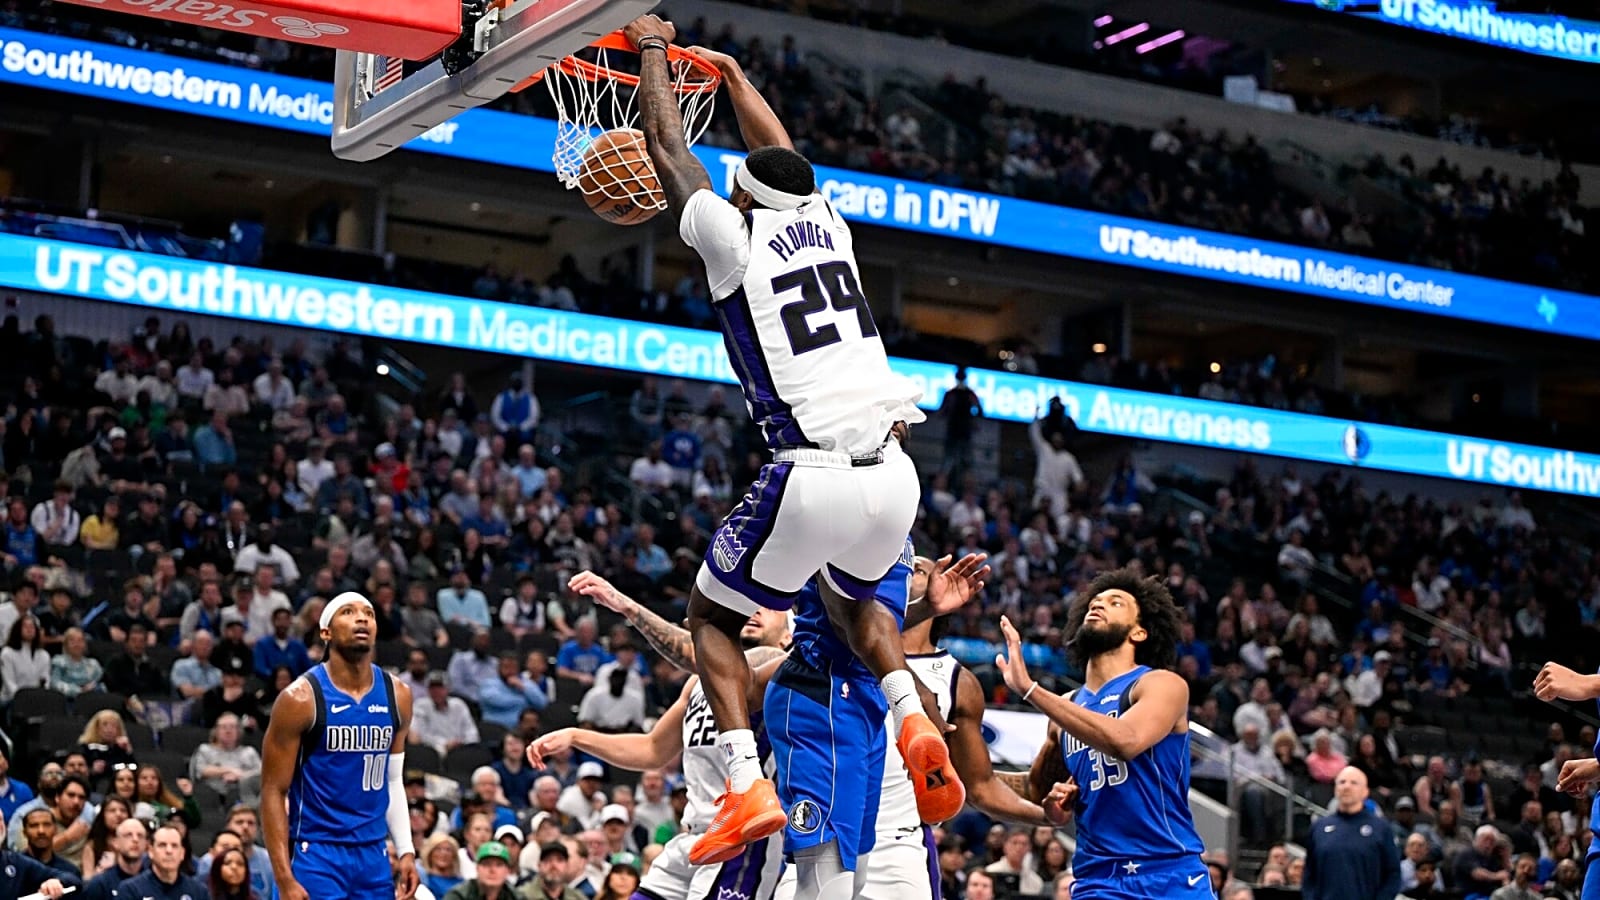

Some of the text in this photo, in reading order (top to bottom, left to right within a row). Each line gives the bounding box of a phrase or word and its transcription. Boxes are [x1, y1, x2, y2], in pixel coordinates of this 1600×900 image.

[0, 39, 241, 109] Southwestern
[821, 179, 1000, 237] care in DFW
[768, 220, 835, 262] PLOWDEN
[770, 260, 878, 356] 29
[1304, 259, 1387, 297] Medical
[1387, 273, 1454, 307] Center
[468, 304, 628, 367] Medical
[635, 328, 738, 377] Cent
[1087, 390, 1271, 450] Awareness
[327, 725, 393, 752] DALLAS
[688, 714, 717, 747] 22
[362, 753, 387, 791] 10
